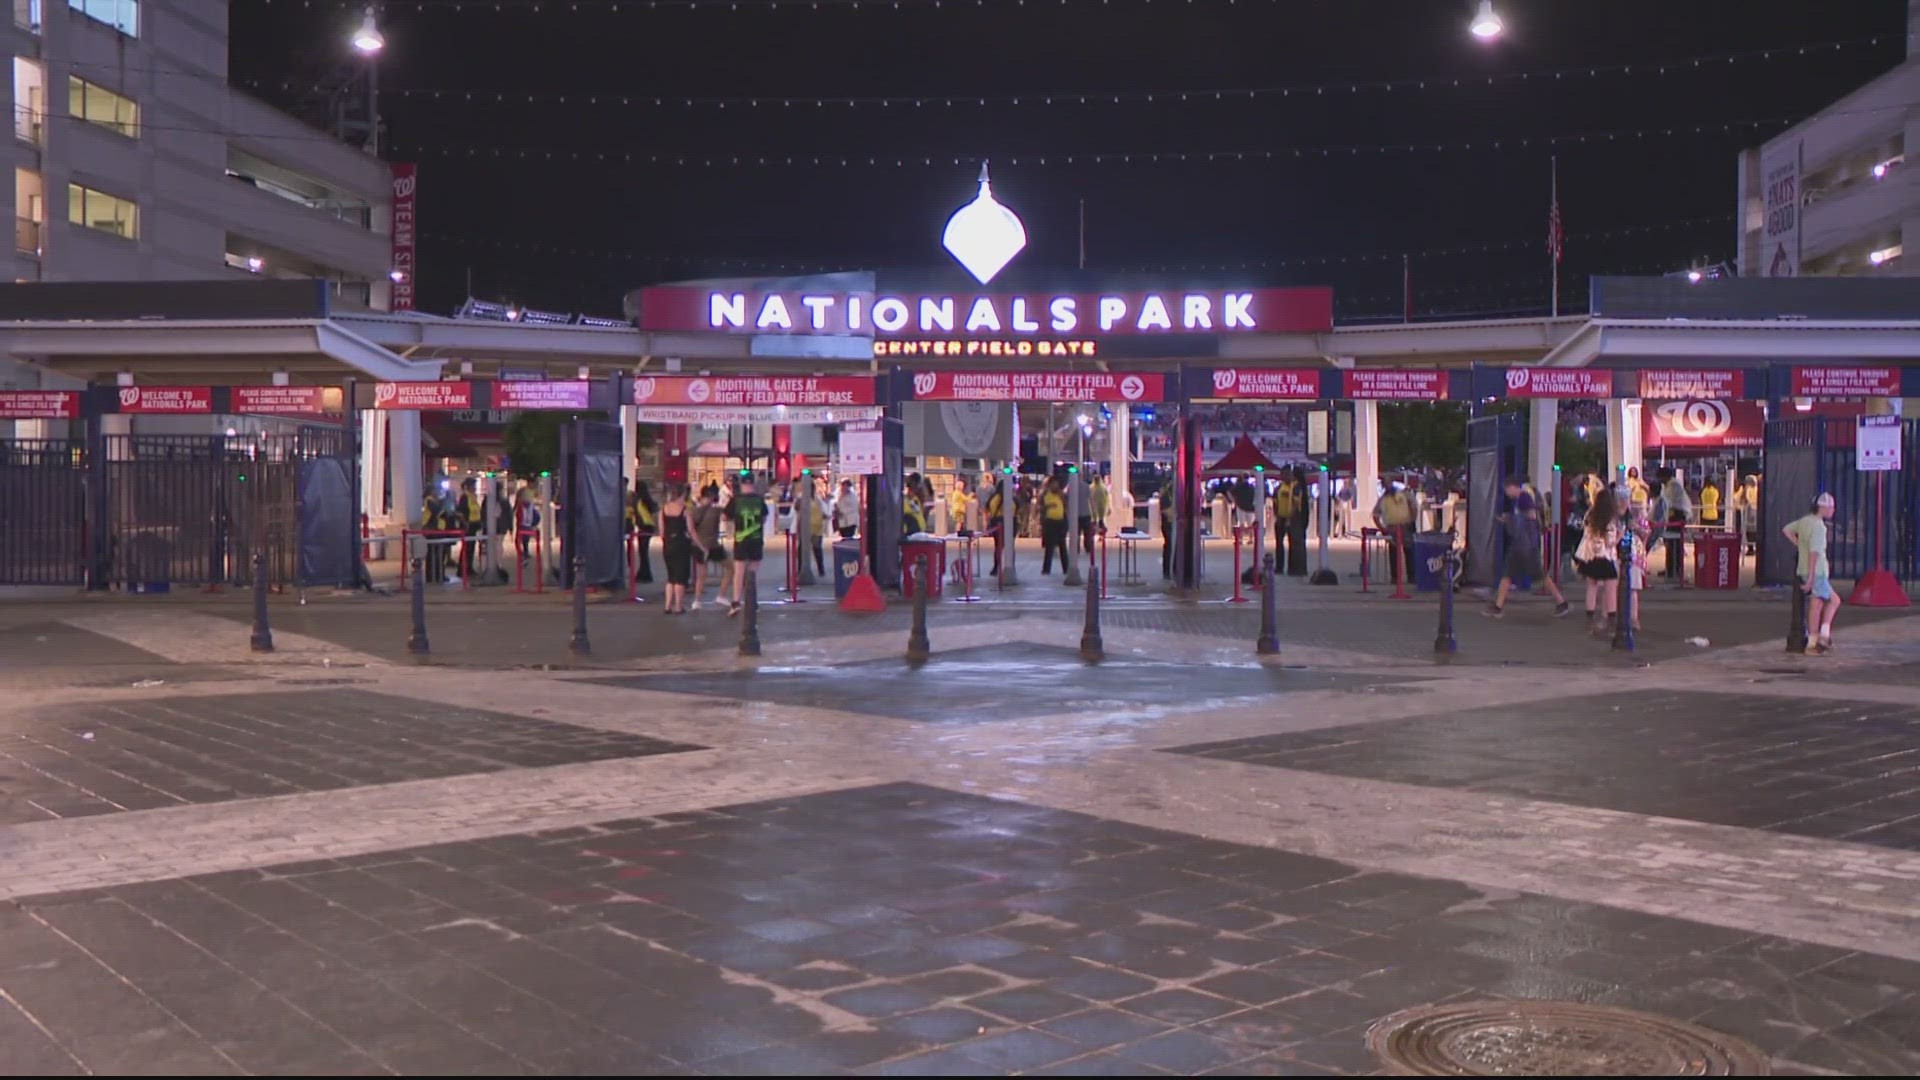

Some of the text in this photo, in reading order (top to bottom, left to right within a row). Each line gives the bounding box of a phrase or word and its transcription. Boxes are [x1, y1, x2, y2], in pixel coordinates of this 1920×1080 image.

[395, 201, 412, 307] TEAM STORE
[709, 292, 1256, 333] NATIONALS PARK
[873, 341, 1096, 355] CENTER FIELD GATE
[1238, 374, 1298, 384] WELCOME TO
[1353, 373, 1438, 382] PLEASE CONTINUE THROUGH
[1531, 373, 1591, 383] WELCOME TO
[1802, 369, 1889, 379] PLEASE CONTINUE THROUGH
[715, 379, 817, 391] ADDITIONAL GATES AT
[953, 375, 1117, 388] ADDITIONAL GATES AT LEFT FIELD,
[1376, 381, 1397, 390] SINGLE
[1398, 381, 1412, 390] FILE
[1413, 381, 1427, 390] LINE
[1826, 379, 1848, 387] SINGLE
[1849, 379, 1863, 387] FILE
[1864, 379, 1879, 387] LINE
[398, 386, 451, 396] WELCOME TO
[1238, 384, 1314, 394] NATIONALS PARK
[1531, 383, 1608, 393] NATIONALS PARK
[142, 391, 192, 400] WELCOME TO
[715, 391, 853, 404] RIGHT FIELD AND FIRST BASE
[953, 387, 1096, 400] THIRD BASE AND HOME PLATE
[142, 400, 207, 408] NATIONALS PARK
[398, 395, 467, 405] NATIONALS PARK
[643, 410, 698, 419] WRISTBAND
[701, 411, 735, 420] PICKUP
[749, 413, 772, 421] BLUE
[802, 412, 817, 420] ON
[834, 410, 869, 419] STREET
[1719, 547, 1729, 587] TRASH
